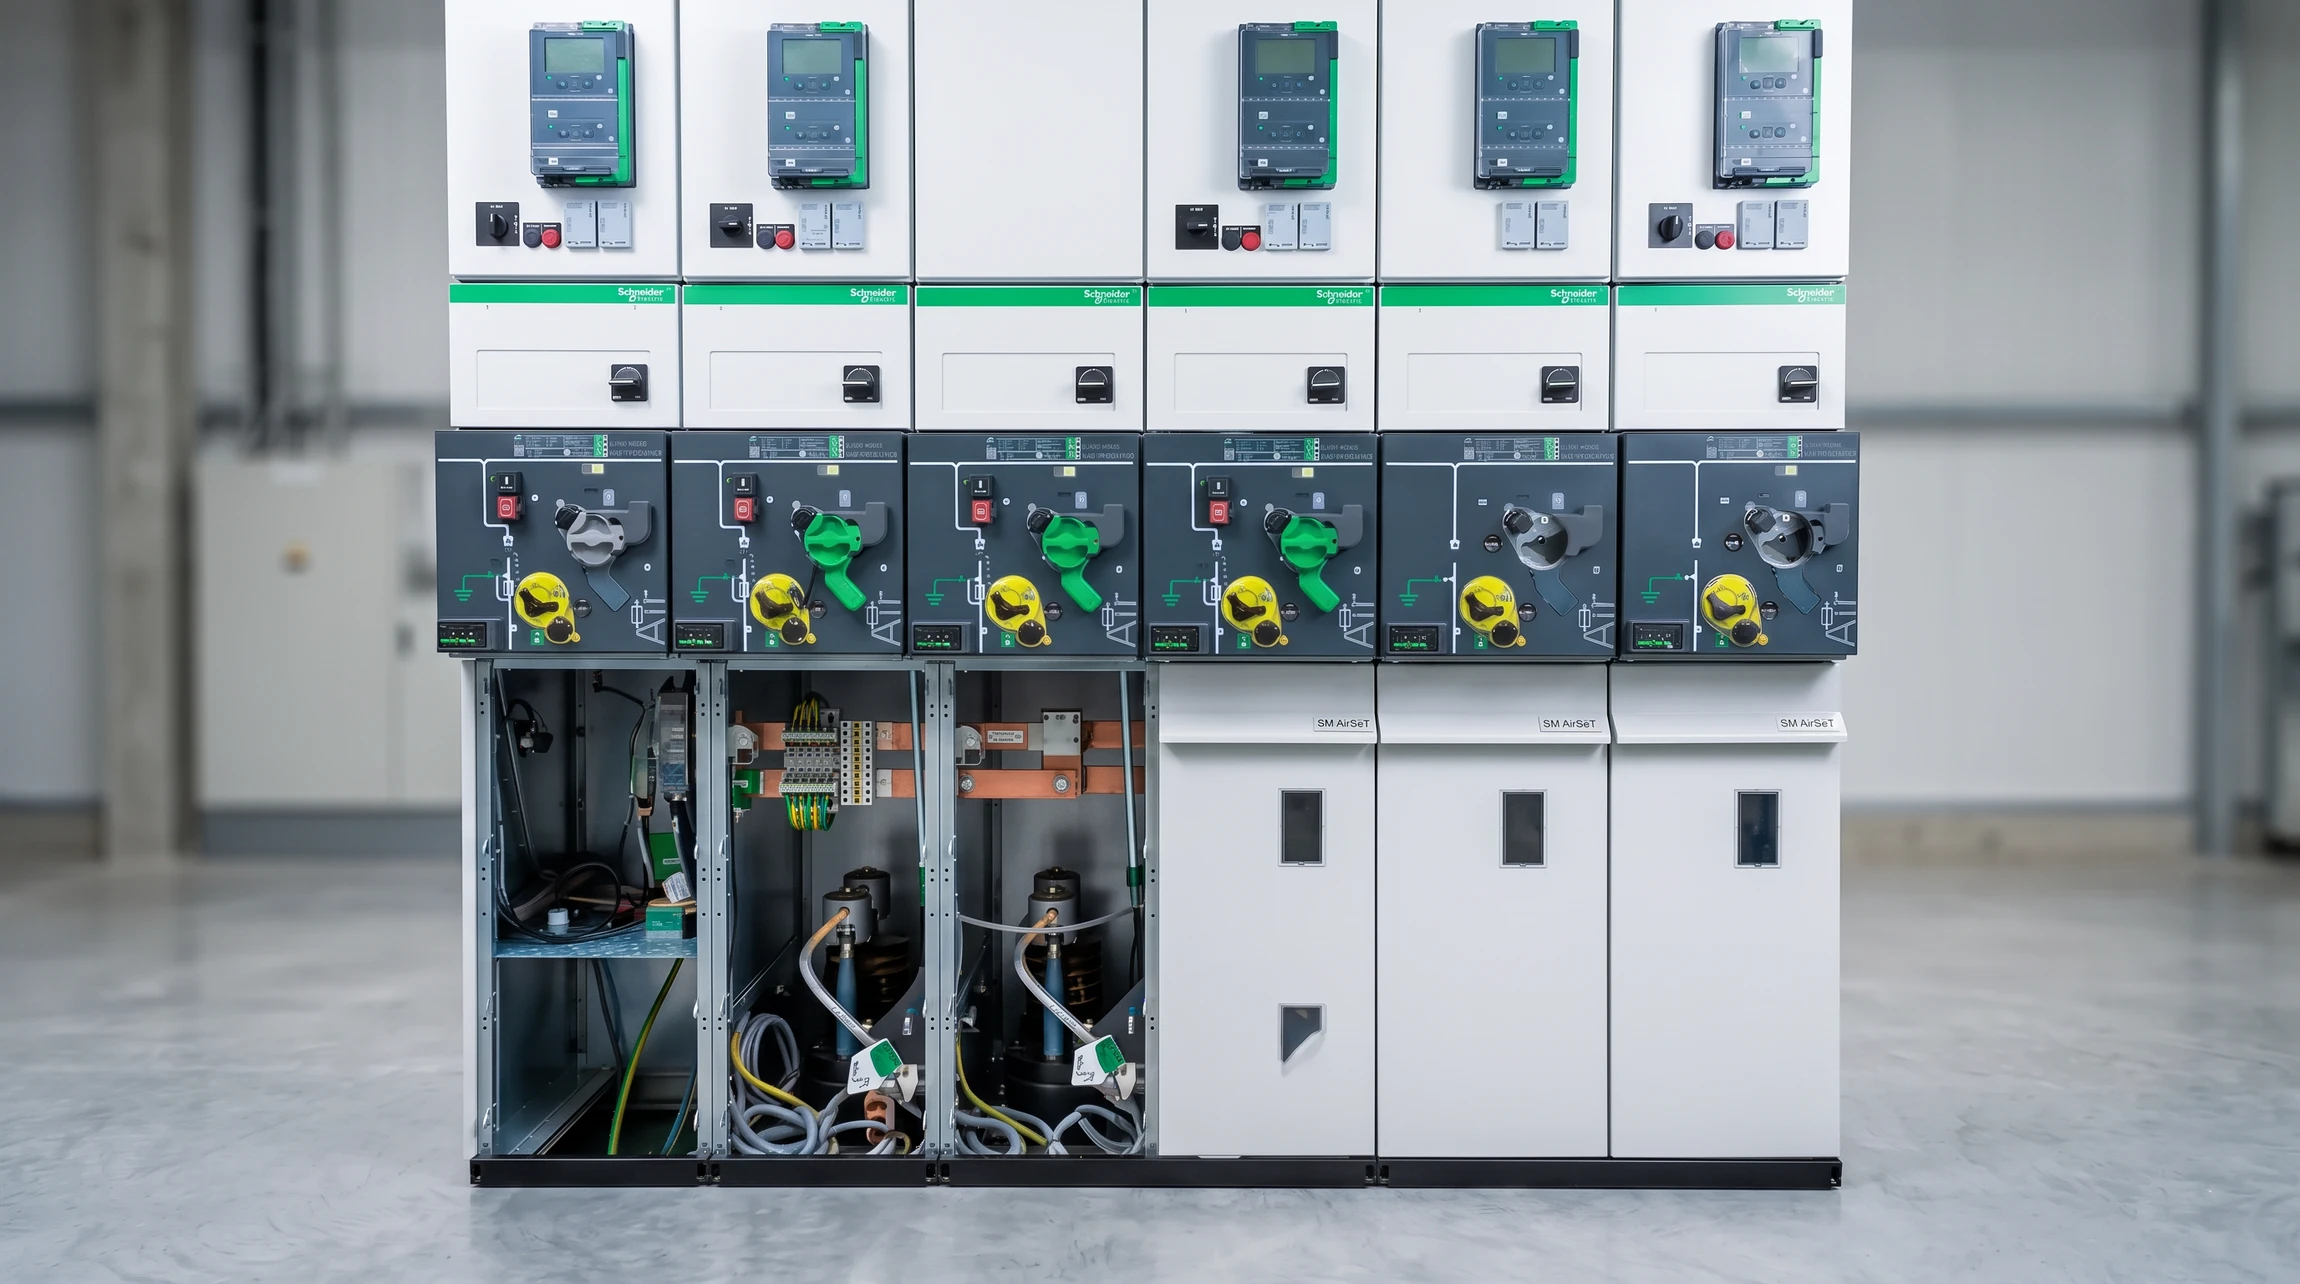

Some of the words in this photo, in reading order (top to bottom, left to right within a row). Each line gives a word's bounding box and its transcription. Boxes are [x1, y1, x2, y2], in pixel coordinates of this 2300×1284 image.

[1317, 719, 1334, 728] SM
[1543, 719, 1560, 728] SM
[1780, 719, 1798, 728] SM
